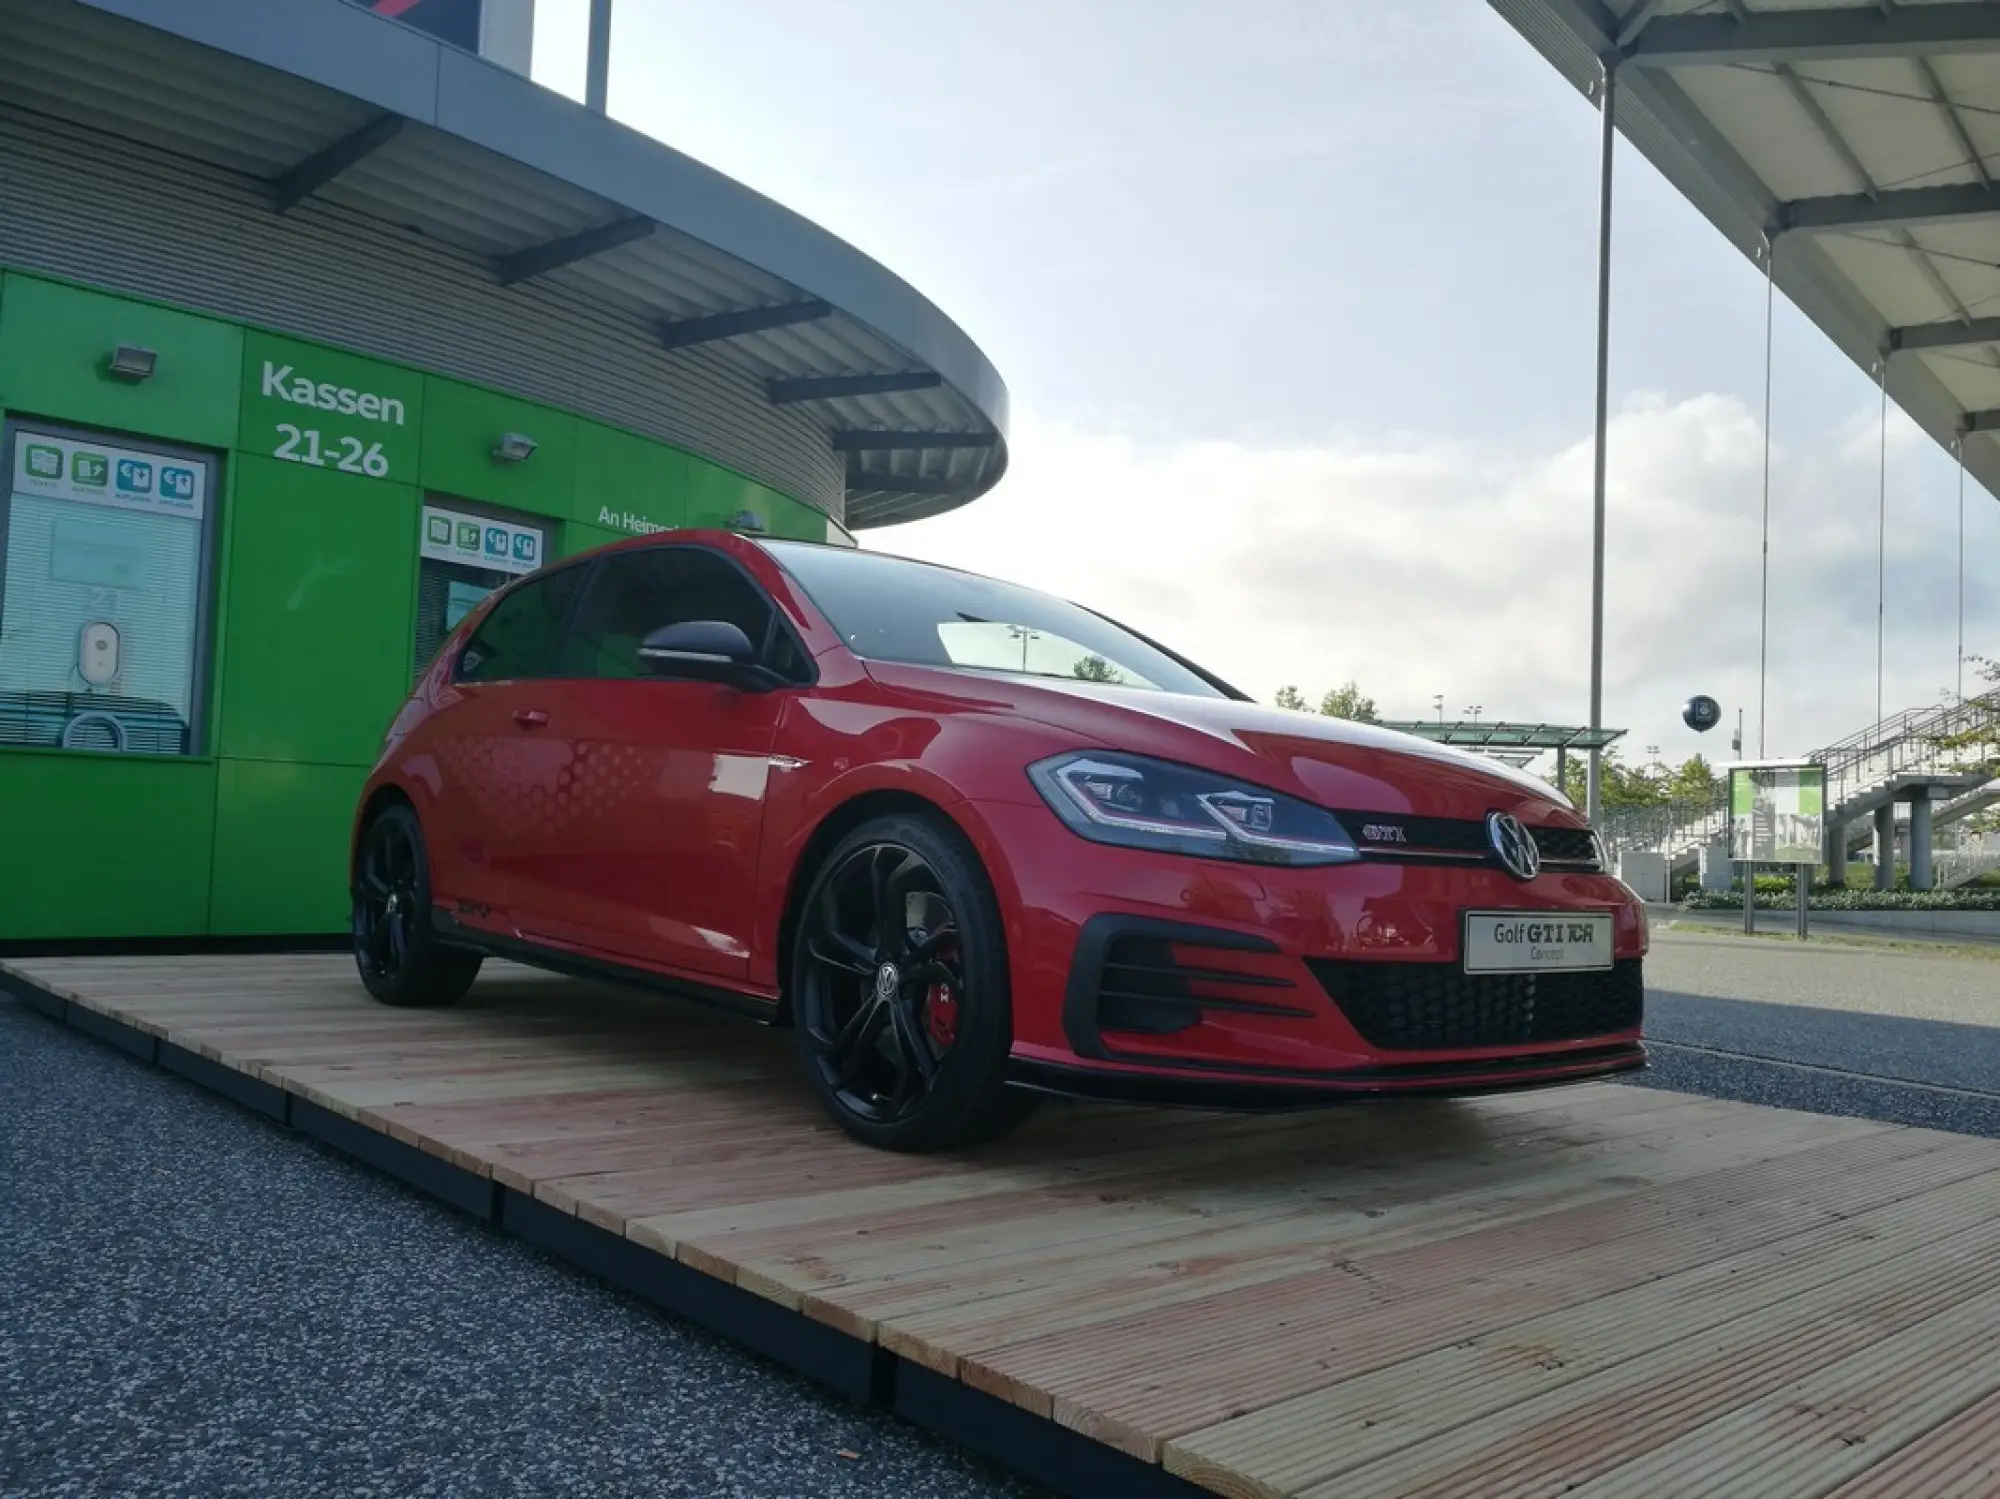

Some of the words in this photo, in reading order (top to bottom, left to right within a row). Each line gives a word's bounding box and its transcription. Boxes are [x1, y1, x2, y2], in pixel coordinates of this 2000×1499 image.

[262, 360, 404, 426] Kassen
[273, 423, 389, 477] 21-26
[598, 505, 619, 528] An
[1494, 923, 1525, 944] Golf
[1527, 923, 1564, 943] GTI
